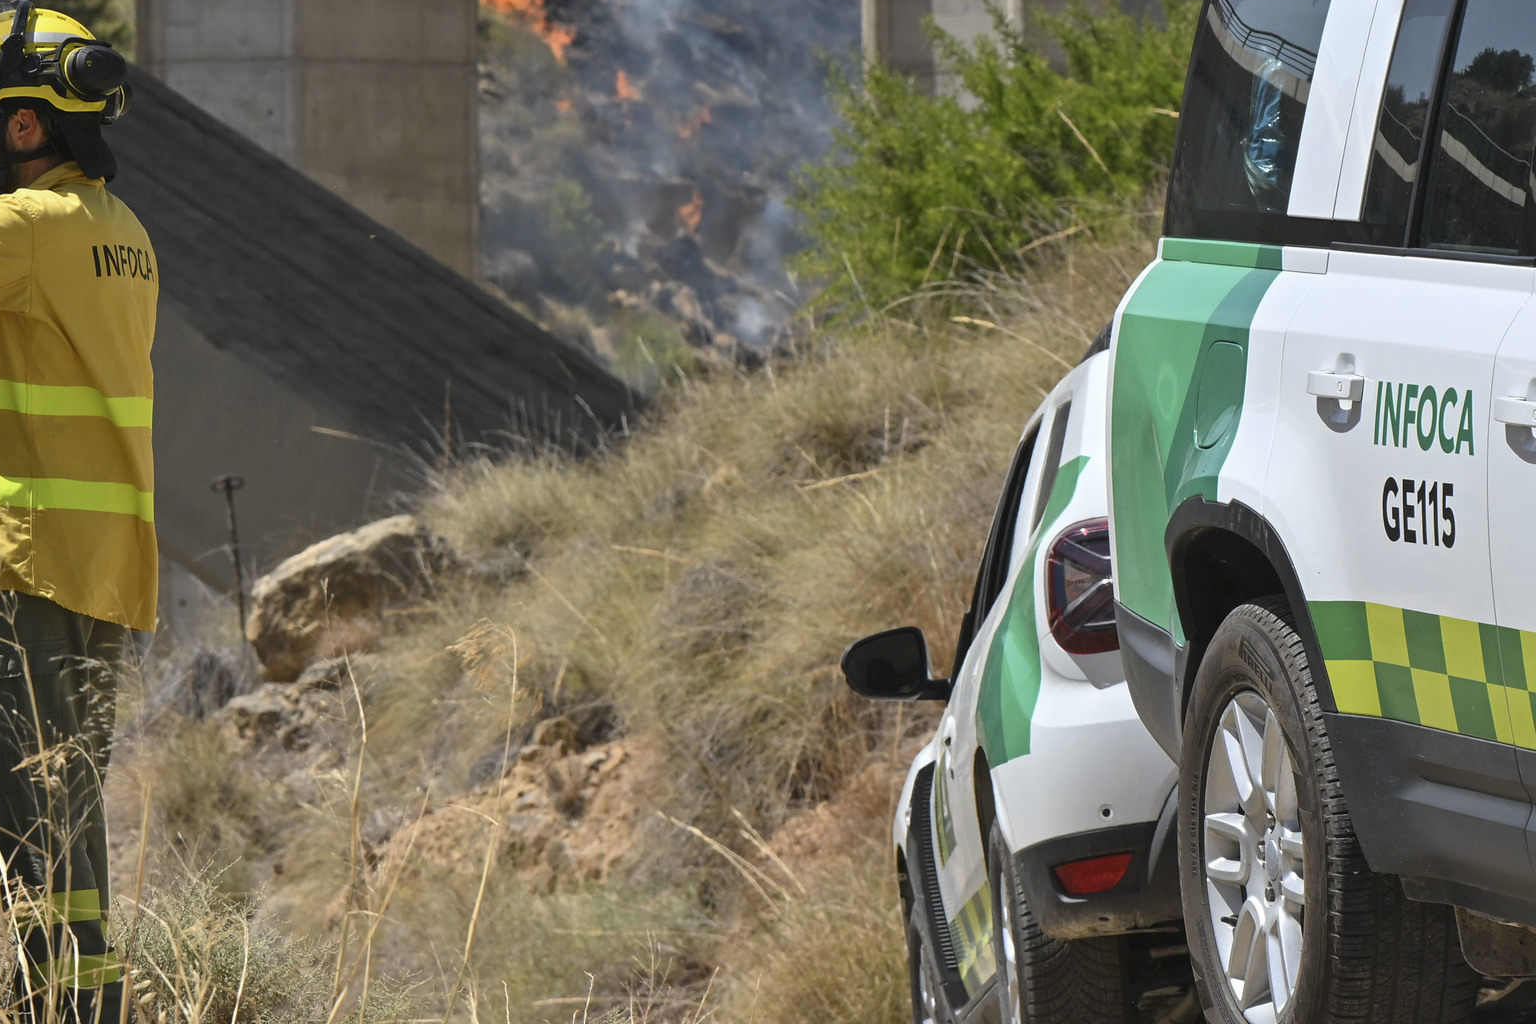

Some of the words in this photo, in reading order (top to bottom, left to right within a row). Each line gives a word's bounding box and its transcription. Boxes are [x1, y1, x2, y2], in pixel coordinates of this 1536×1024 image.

[92, 244, 154, 283] INFOCA
[1374, 381, 1474, 455] INFOCA
[1382, 476, 1456, 549] GE115
